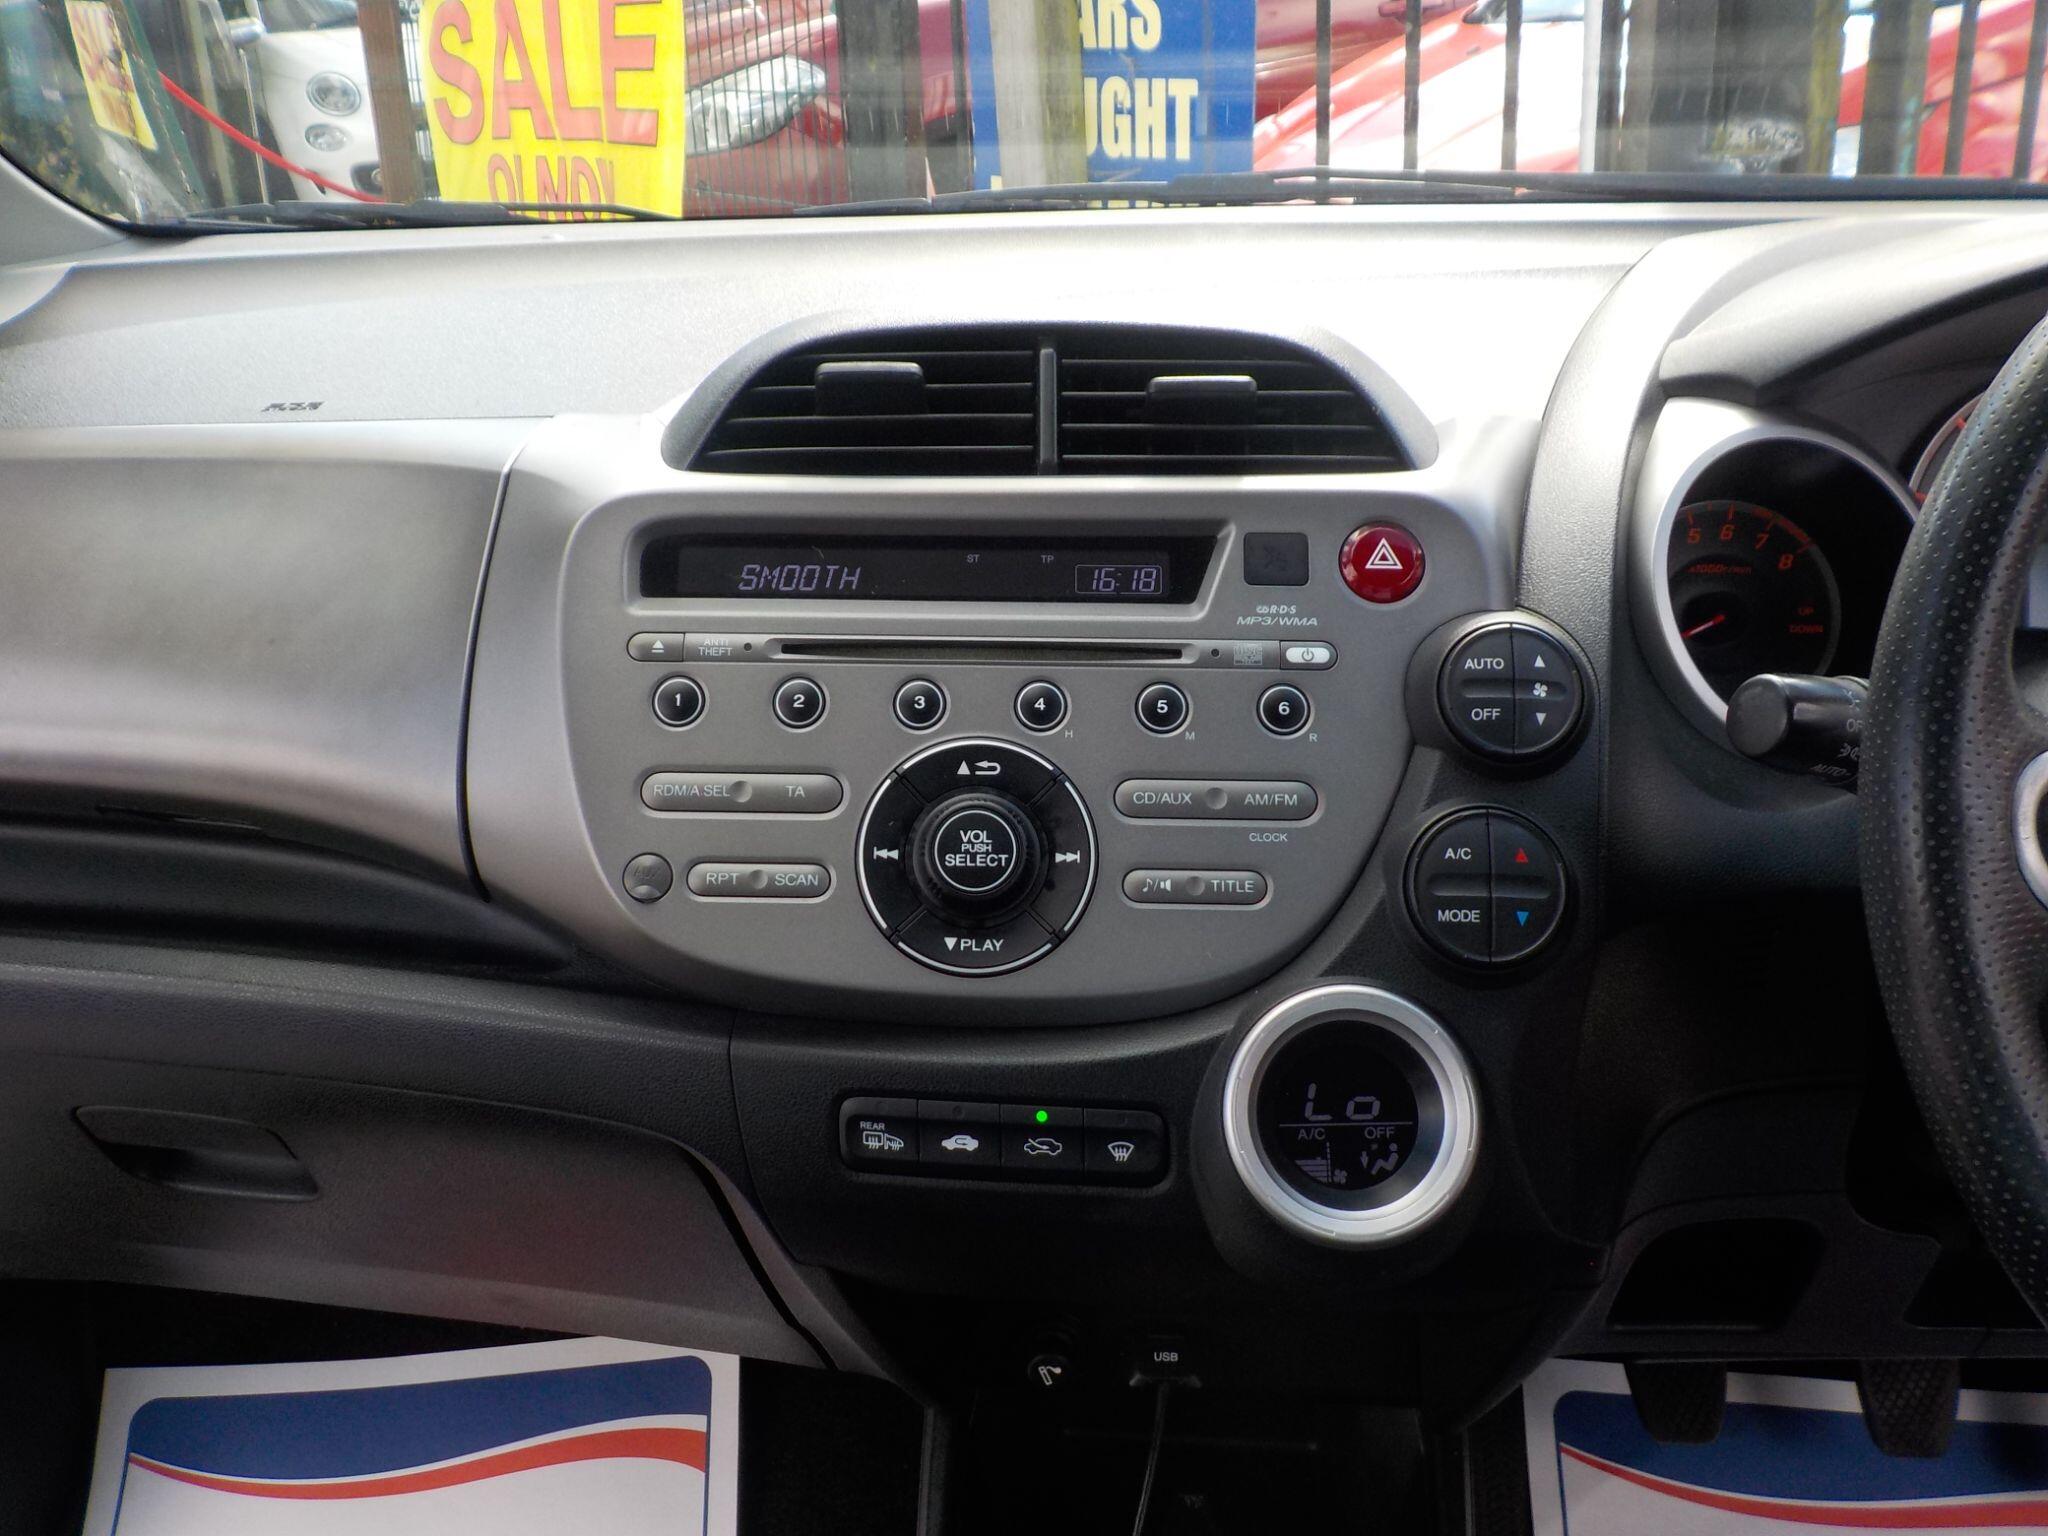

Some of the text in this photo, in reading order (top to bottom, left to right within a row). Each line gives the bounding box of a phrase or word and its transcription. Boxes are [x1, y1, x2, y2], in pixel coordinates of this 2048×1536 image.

[1080, 0, 1162, 51] ARS
[429, 0, 660, 147] SALE
[1083, 76, 1199, 161] UGHT
[1686, 527, 1701, 544] 5
[1719, 524, 1735, 541] 6
[1755, 533, 1769, 550] 7
[966, 554, 980, 563] ST
[1041, 555, 1054, 564] TP
[1777, 553, 1794, 571] 8
[738, 564, 861, 591] SMOOTH
[1090, 567, 1157, 593] 16:18
[1236, 615, 1318, 626] MP3/WMA
[698, 646, 732, 656] THEFT
[1464, 657, 1505, 670] AUTO
[674, 693, 682, 708] 1
[792, 694, 805, 708] 2
[914, 696, 926, 710] 3
[1033, 697, 1047, 711] 4
[1156, 699, 1168, 714] 5
[1278, 701, 1290, 716] 6
[1470, 708, 1501, 721] OFF
[1064, 730, 1073, 738] H
[1185, 731, 1195, 740] M
[1309, 733, 1318, 742] R
[784, 785, 806, 799] TA
[1132, 791, 1192, 805] CD/AUX
[1243, 793, 1298, 806] AM/FM
[959, 829, 992, 844] VOL
[1249, 832, 1288, 842] CLOCK
[960, 843, 992, 853] PUSH
[1444, 847, 1472, 860] A/C
[944, 853, 1009, 868] SELECT
[705, 872, 740, 886] RPT
[773, 872, 819, 887] SCAN
[1210, 879, 1256, 893] TITLE
[1437, 909, 1480, 923] MODE
[960, 937, 1004, 952] PLAY
[860, 1121, 885, 1130] REAR
[1364, 1126, 1396, 1139] OFF
[1297, 1127, 1326, 1141] A/C
[1154, 1351, 1178, 1362] USB
